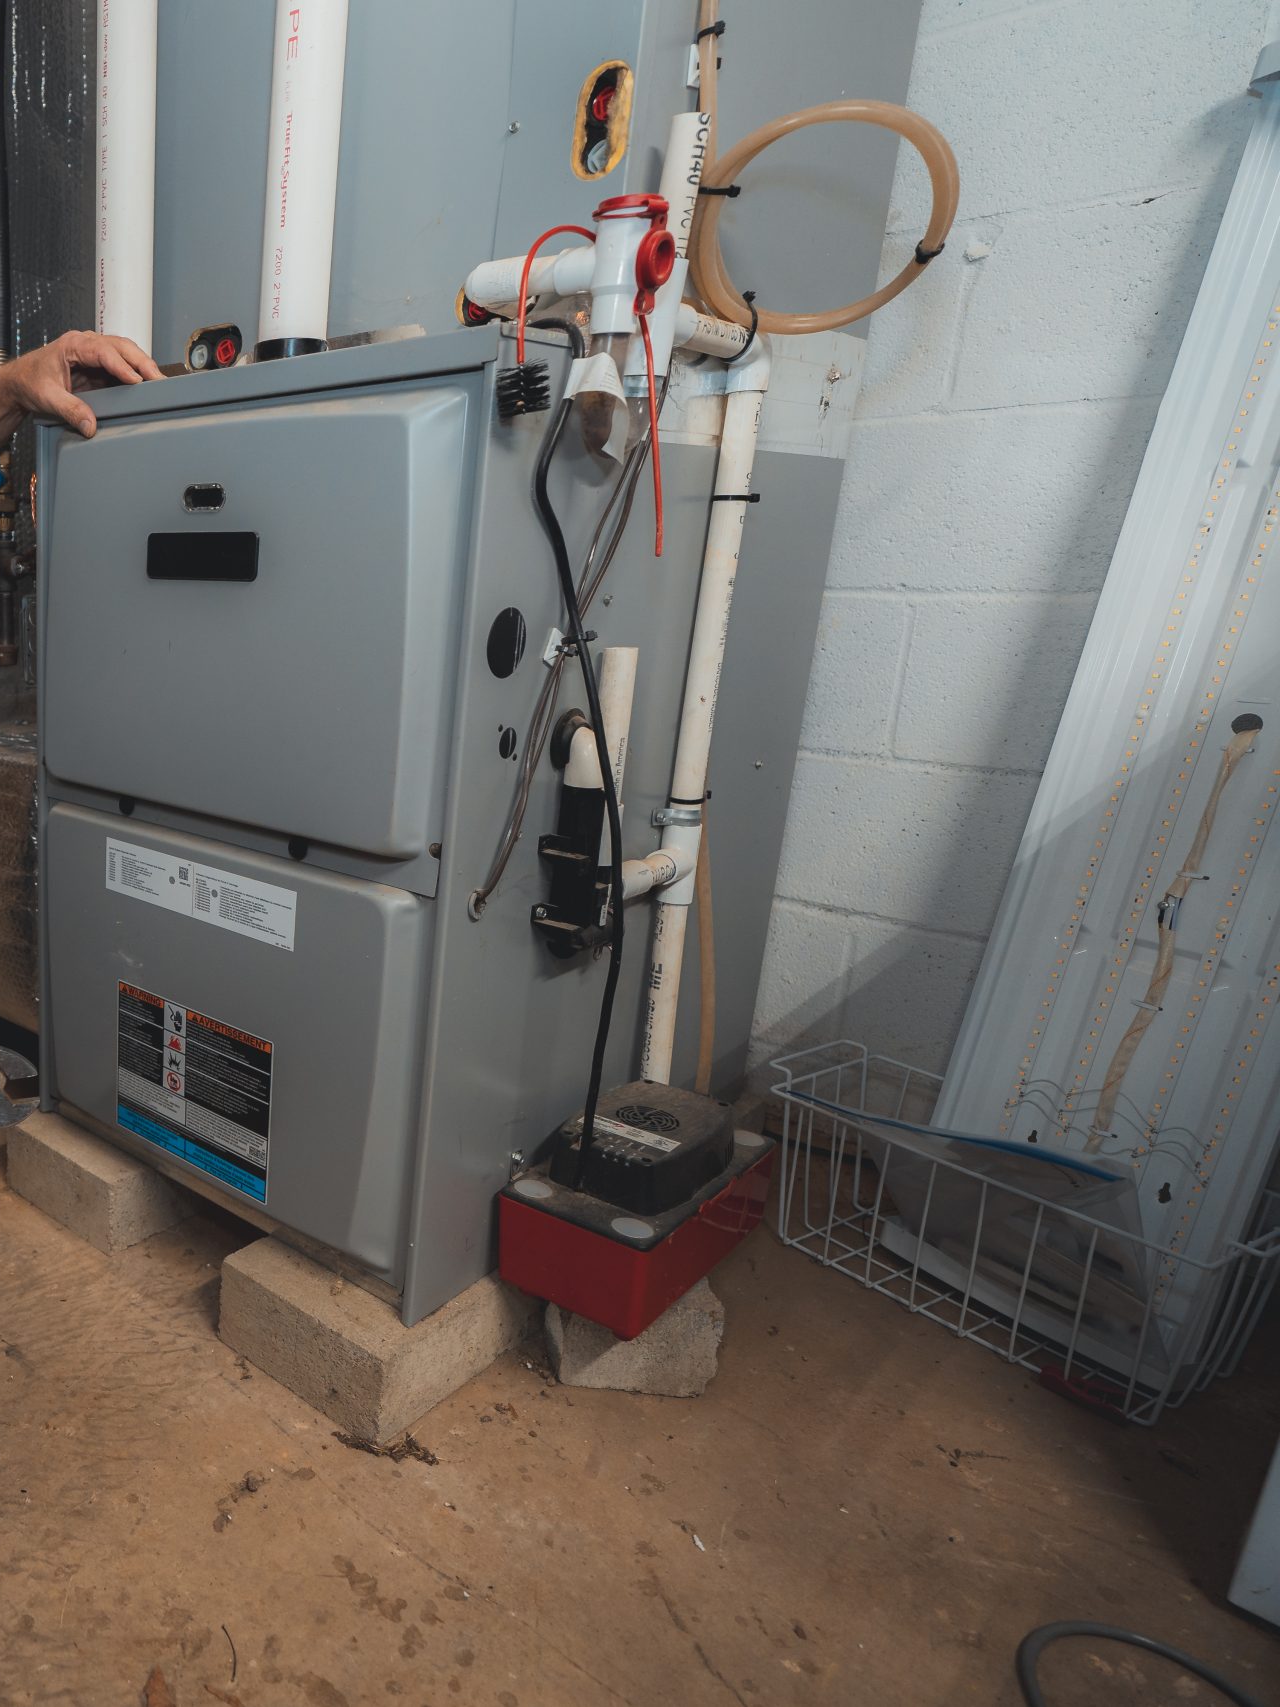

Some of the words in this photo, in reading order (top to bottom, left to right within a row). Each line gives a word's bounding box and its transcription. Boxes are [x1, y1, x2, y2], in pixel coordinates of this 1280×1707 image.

[287, 0, 300, 61] PE
[128, 985, 162, 1006] WARNING
[199, 1015, 267, 1051] AVERTISSEMENT
